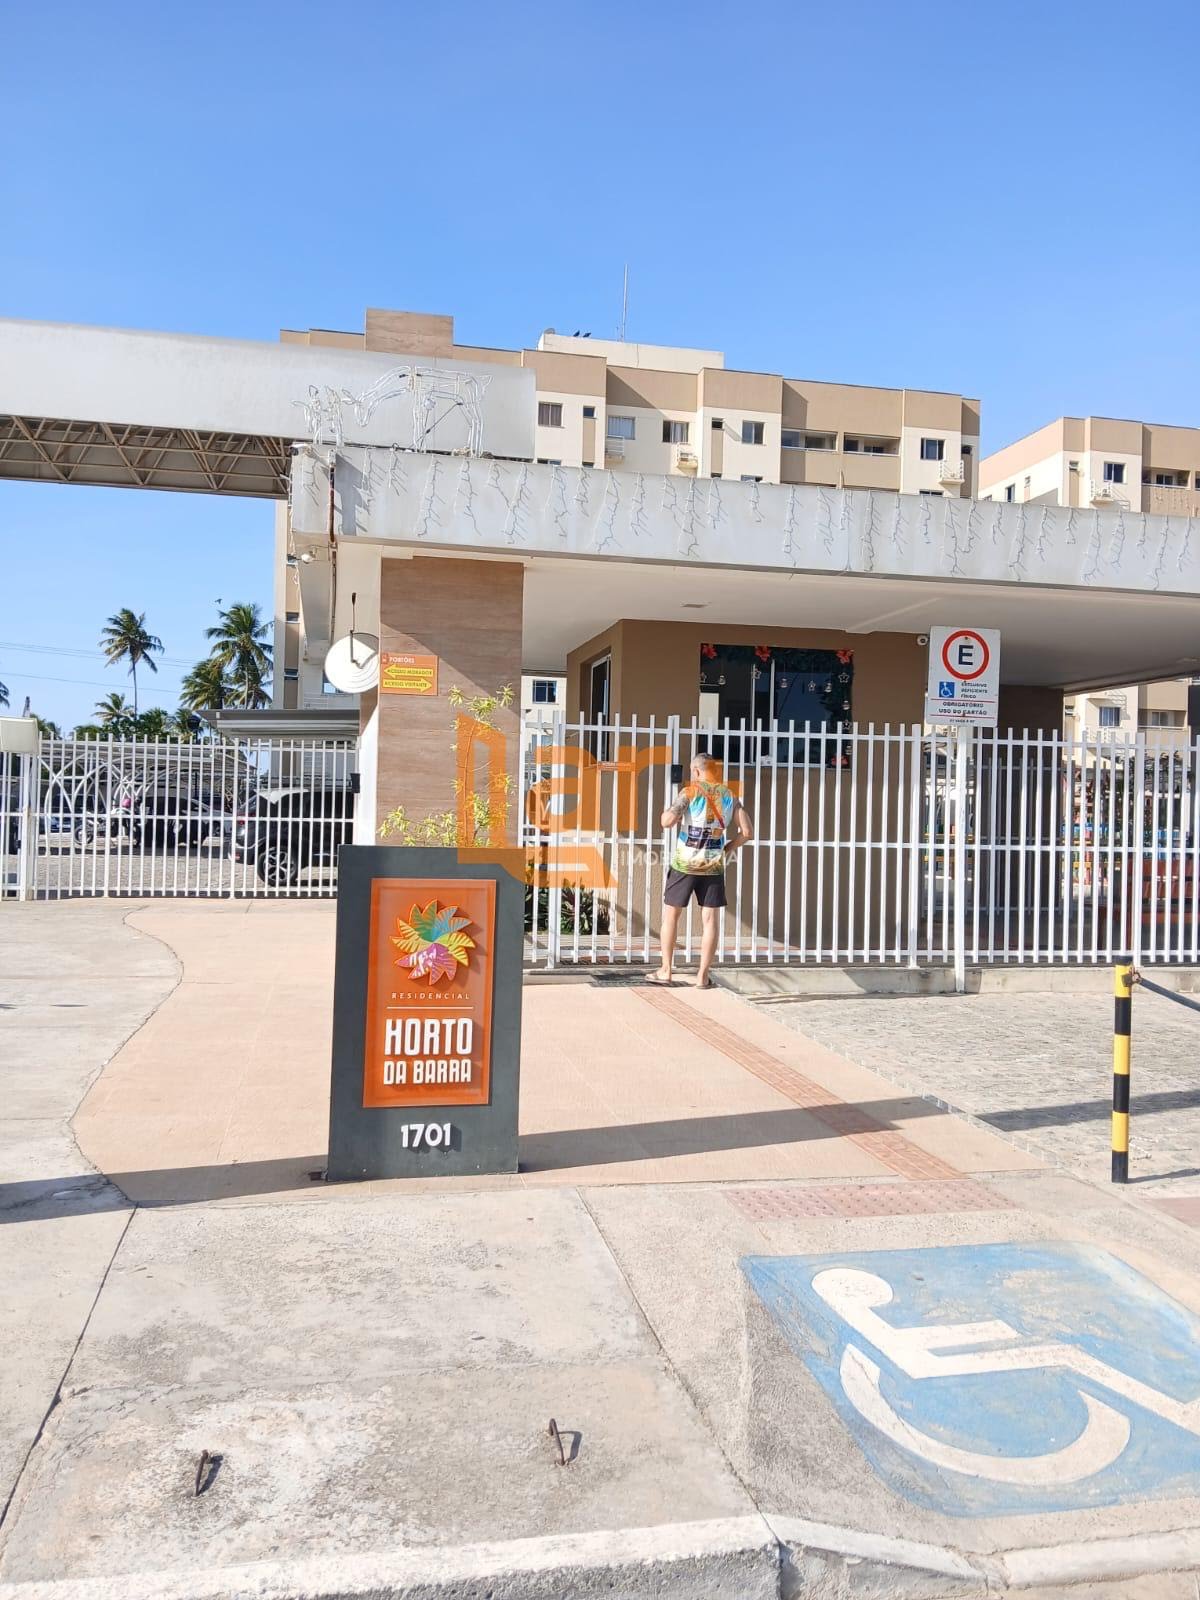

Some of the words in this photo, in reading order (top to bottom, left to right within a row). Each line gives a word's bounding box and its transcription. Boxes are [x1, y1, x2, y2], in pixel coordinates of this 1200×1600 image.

[958, 644, 974, 666] E
[391, 991, 471, 1000] RESIDENCIAL
[384, 1017, 473, 1056] HORTO
[383, 1060, 407, 1085] DA
[413, 1058, 472, 1084] BARRA
[400, 1122, 452, 1148] 1701
